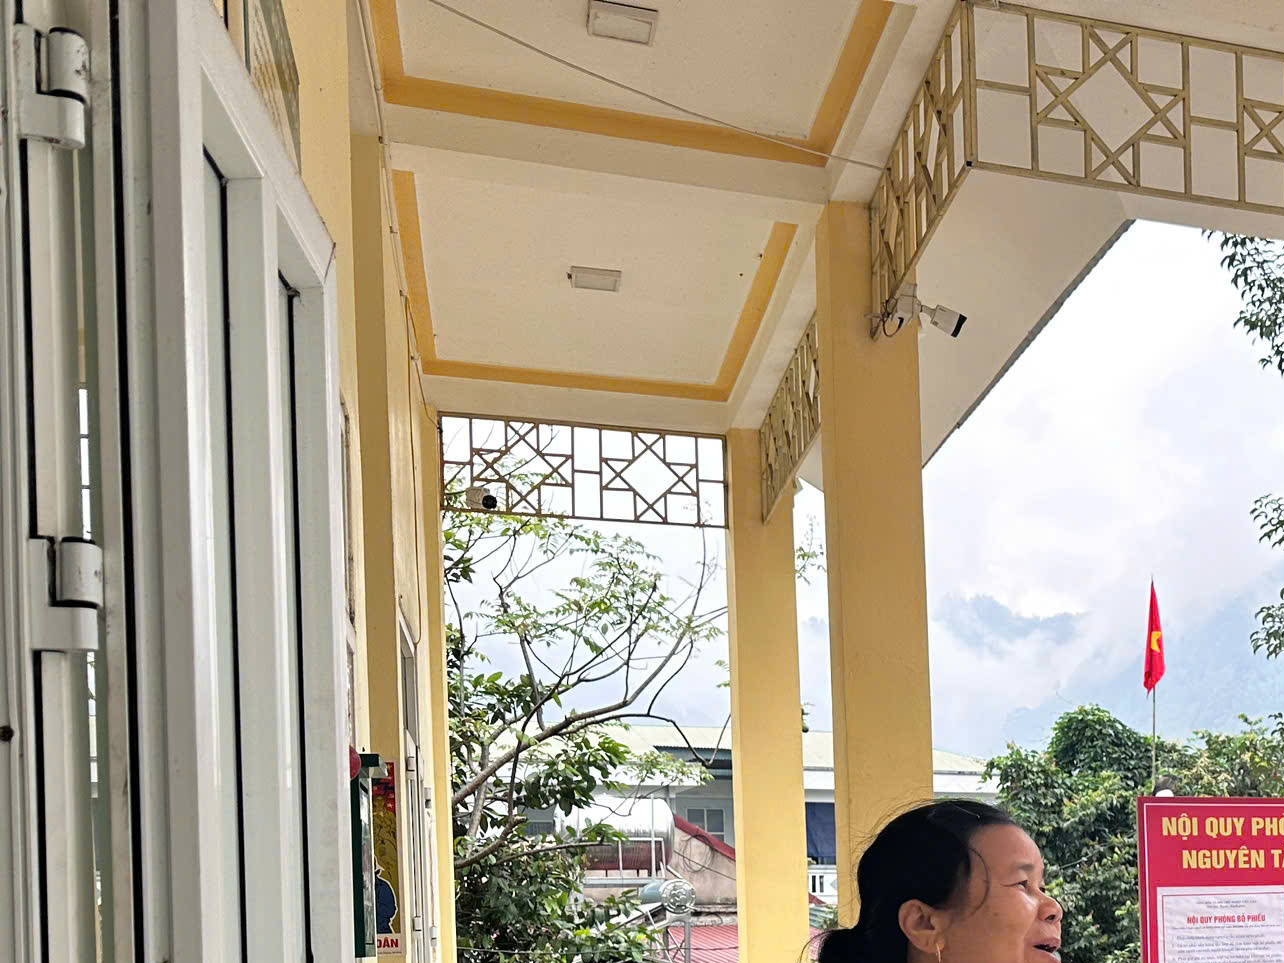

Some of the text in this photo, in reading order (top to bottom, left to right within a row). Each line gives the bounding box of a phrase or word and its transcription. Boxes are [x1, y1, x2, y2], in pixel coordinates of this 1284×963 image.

[1161, 812, 1198, 840] NỘI
[1205, 817, 1245, 838] QUY
[1182, 845, 1265, 869] NGUYÊN
